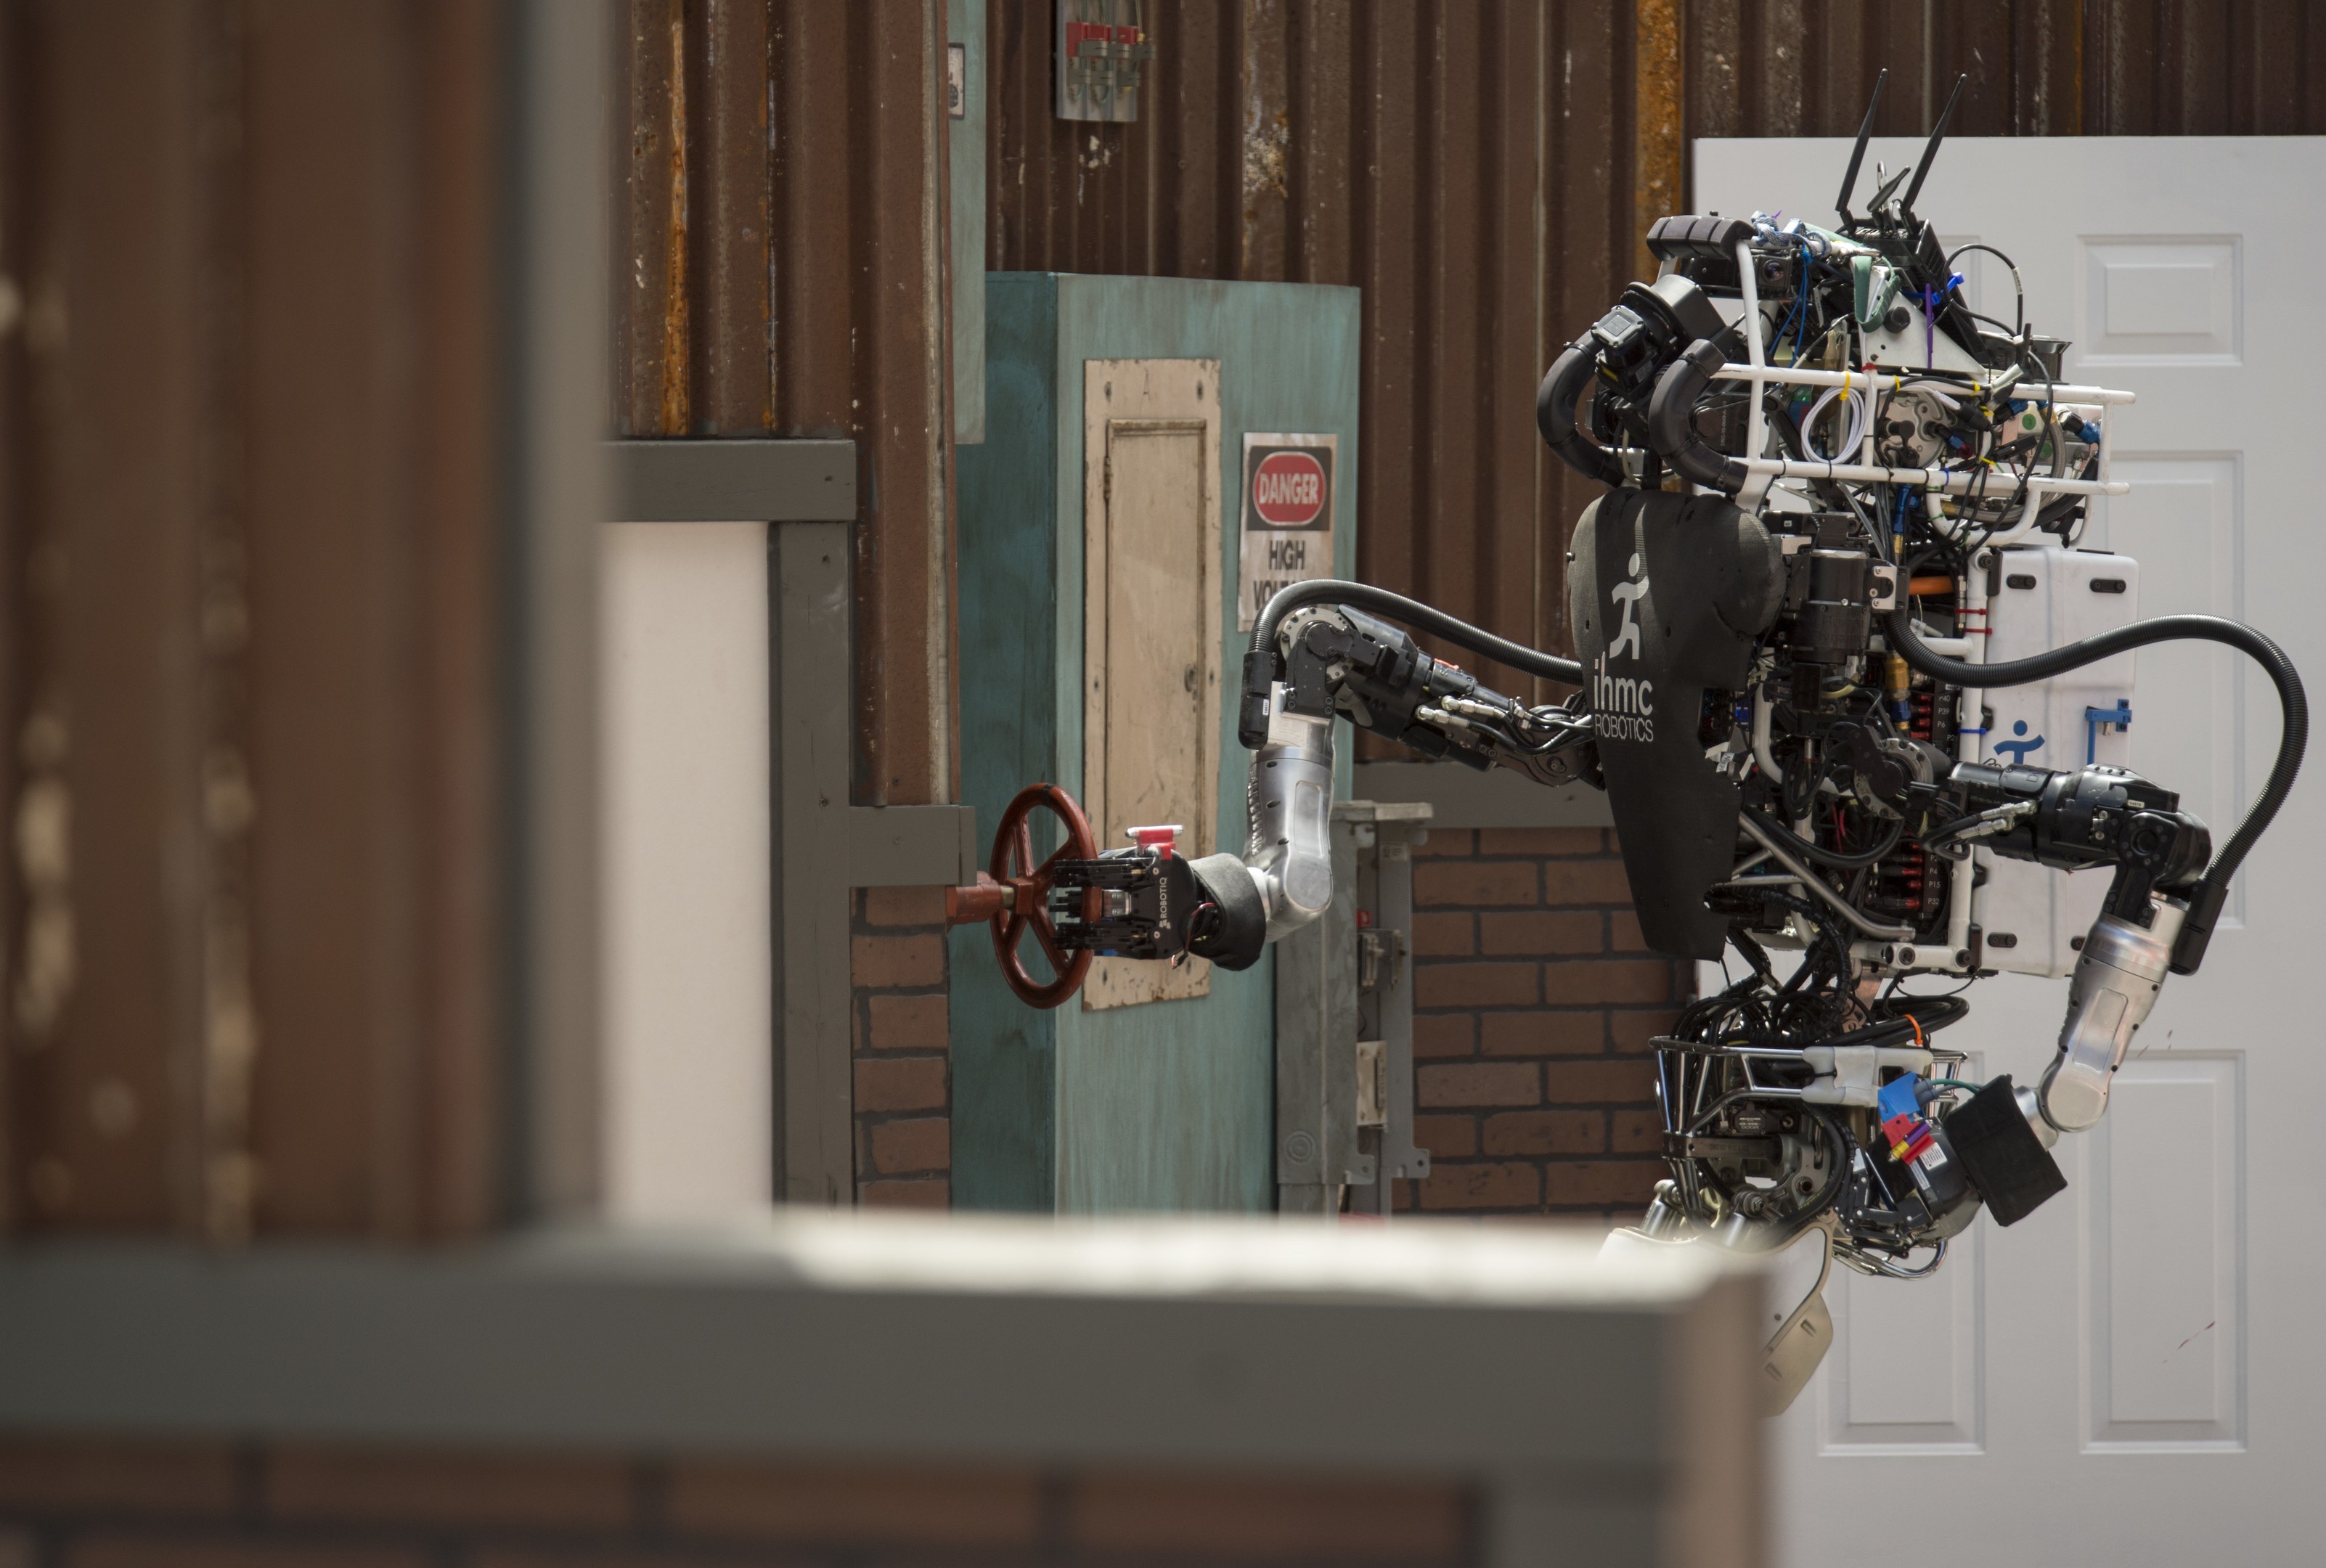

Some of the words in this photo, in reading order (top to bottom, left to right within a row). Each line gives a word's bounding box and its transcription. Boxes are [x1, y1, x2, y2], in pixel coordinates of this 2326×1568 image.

[1259, 473, 1320, 505] DANGER
[1269, 539, 1305, 570] HIGH
[1594, 651, 1653, 716] ihmc
[1595, 713, 1654, 742] ROBOTICS
